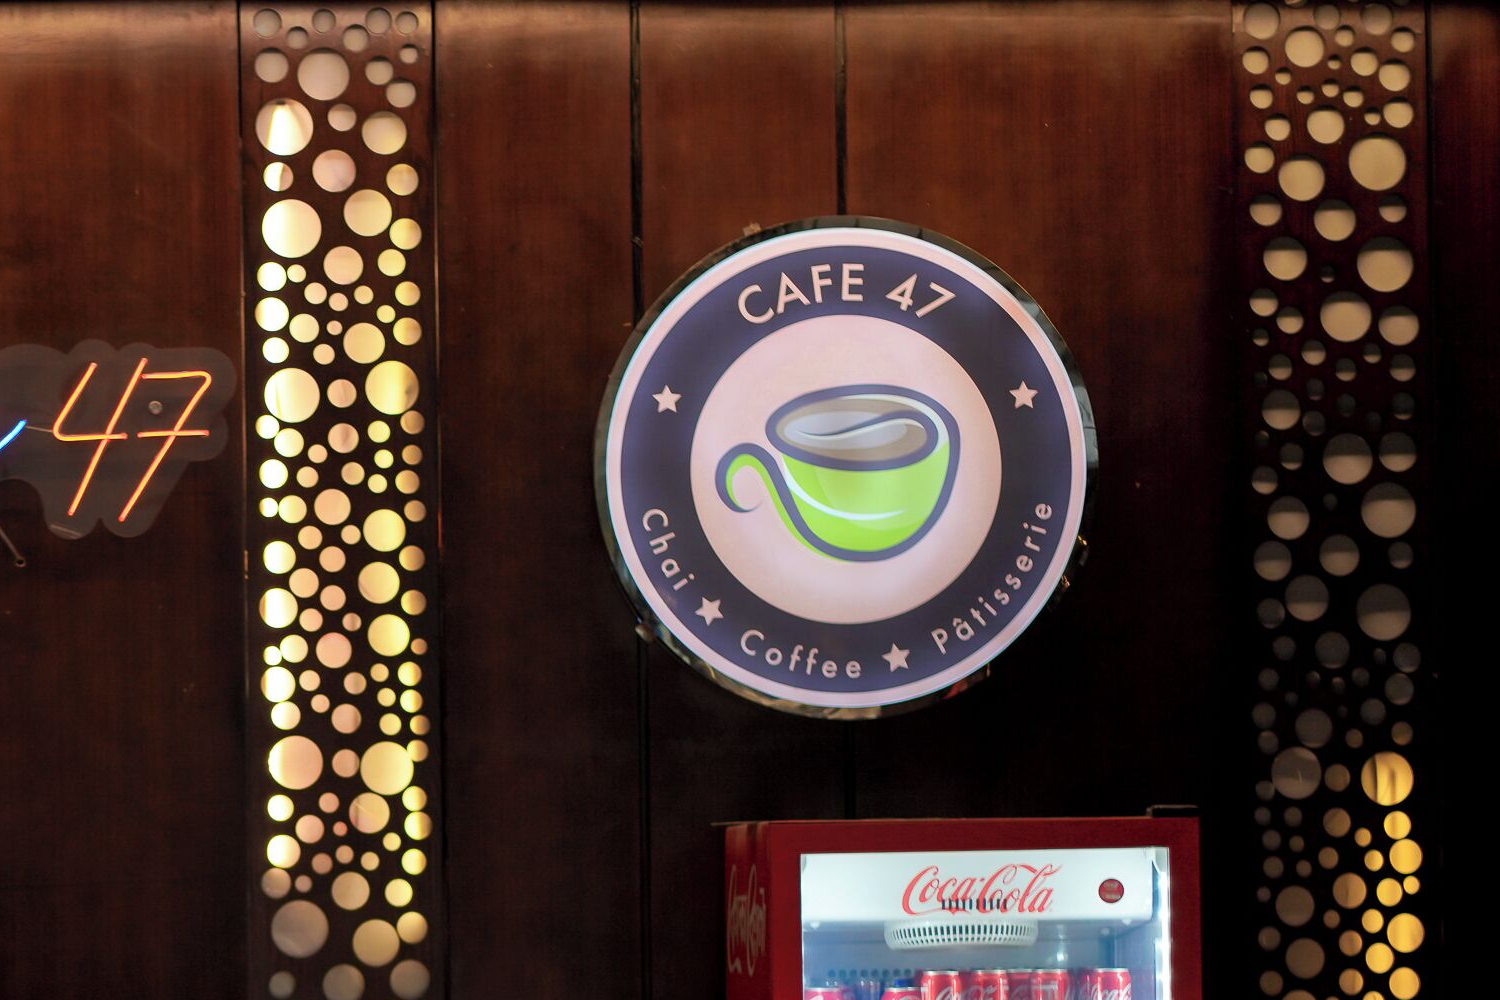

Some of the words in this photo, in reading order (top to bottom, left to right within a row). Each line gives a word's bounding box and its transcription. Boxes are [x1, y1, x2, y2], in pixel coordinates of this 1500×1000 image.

[737, 263, 864, 325] CAFE
[886, 273, 956, 319] 47
[51, 357, 213, 522] 47
[642, 508, 695, 591] Chai
[931, 502, 1053, 655] Pâtisserie
[740, 629, 861, 679] Coffee
[902, 863, 1063, 916] Coca-Cola
